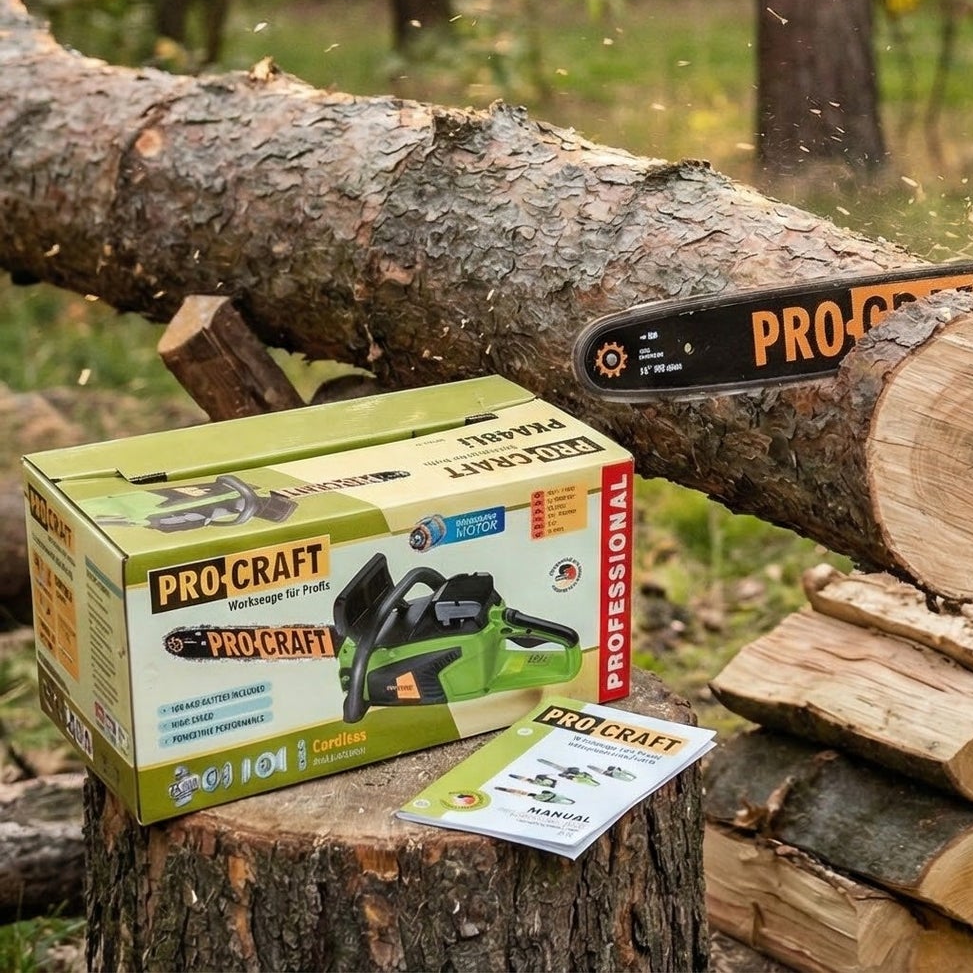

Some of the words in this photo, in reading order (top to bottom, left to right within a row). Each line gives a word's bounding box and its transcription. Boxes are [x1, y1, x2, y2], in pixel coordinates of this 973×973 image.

[456, 519, 498, 538] MOTOR
[607, 473, 628, 691] PROFESSIONAL
[312, 731, 367, 754] Cordless
[527, 806, 591, 824] MANUAL
